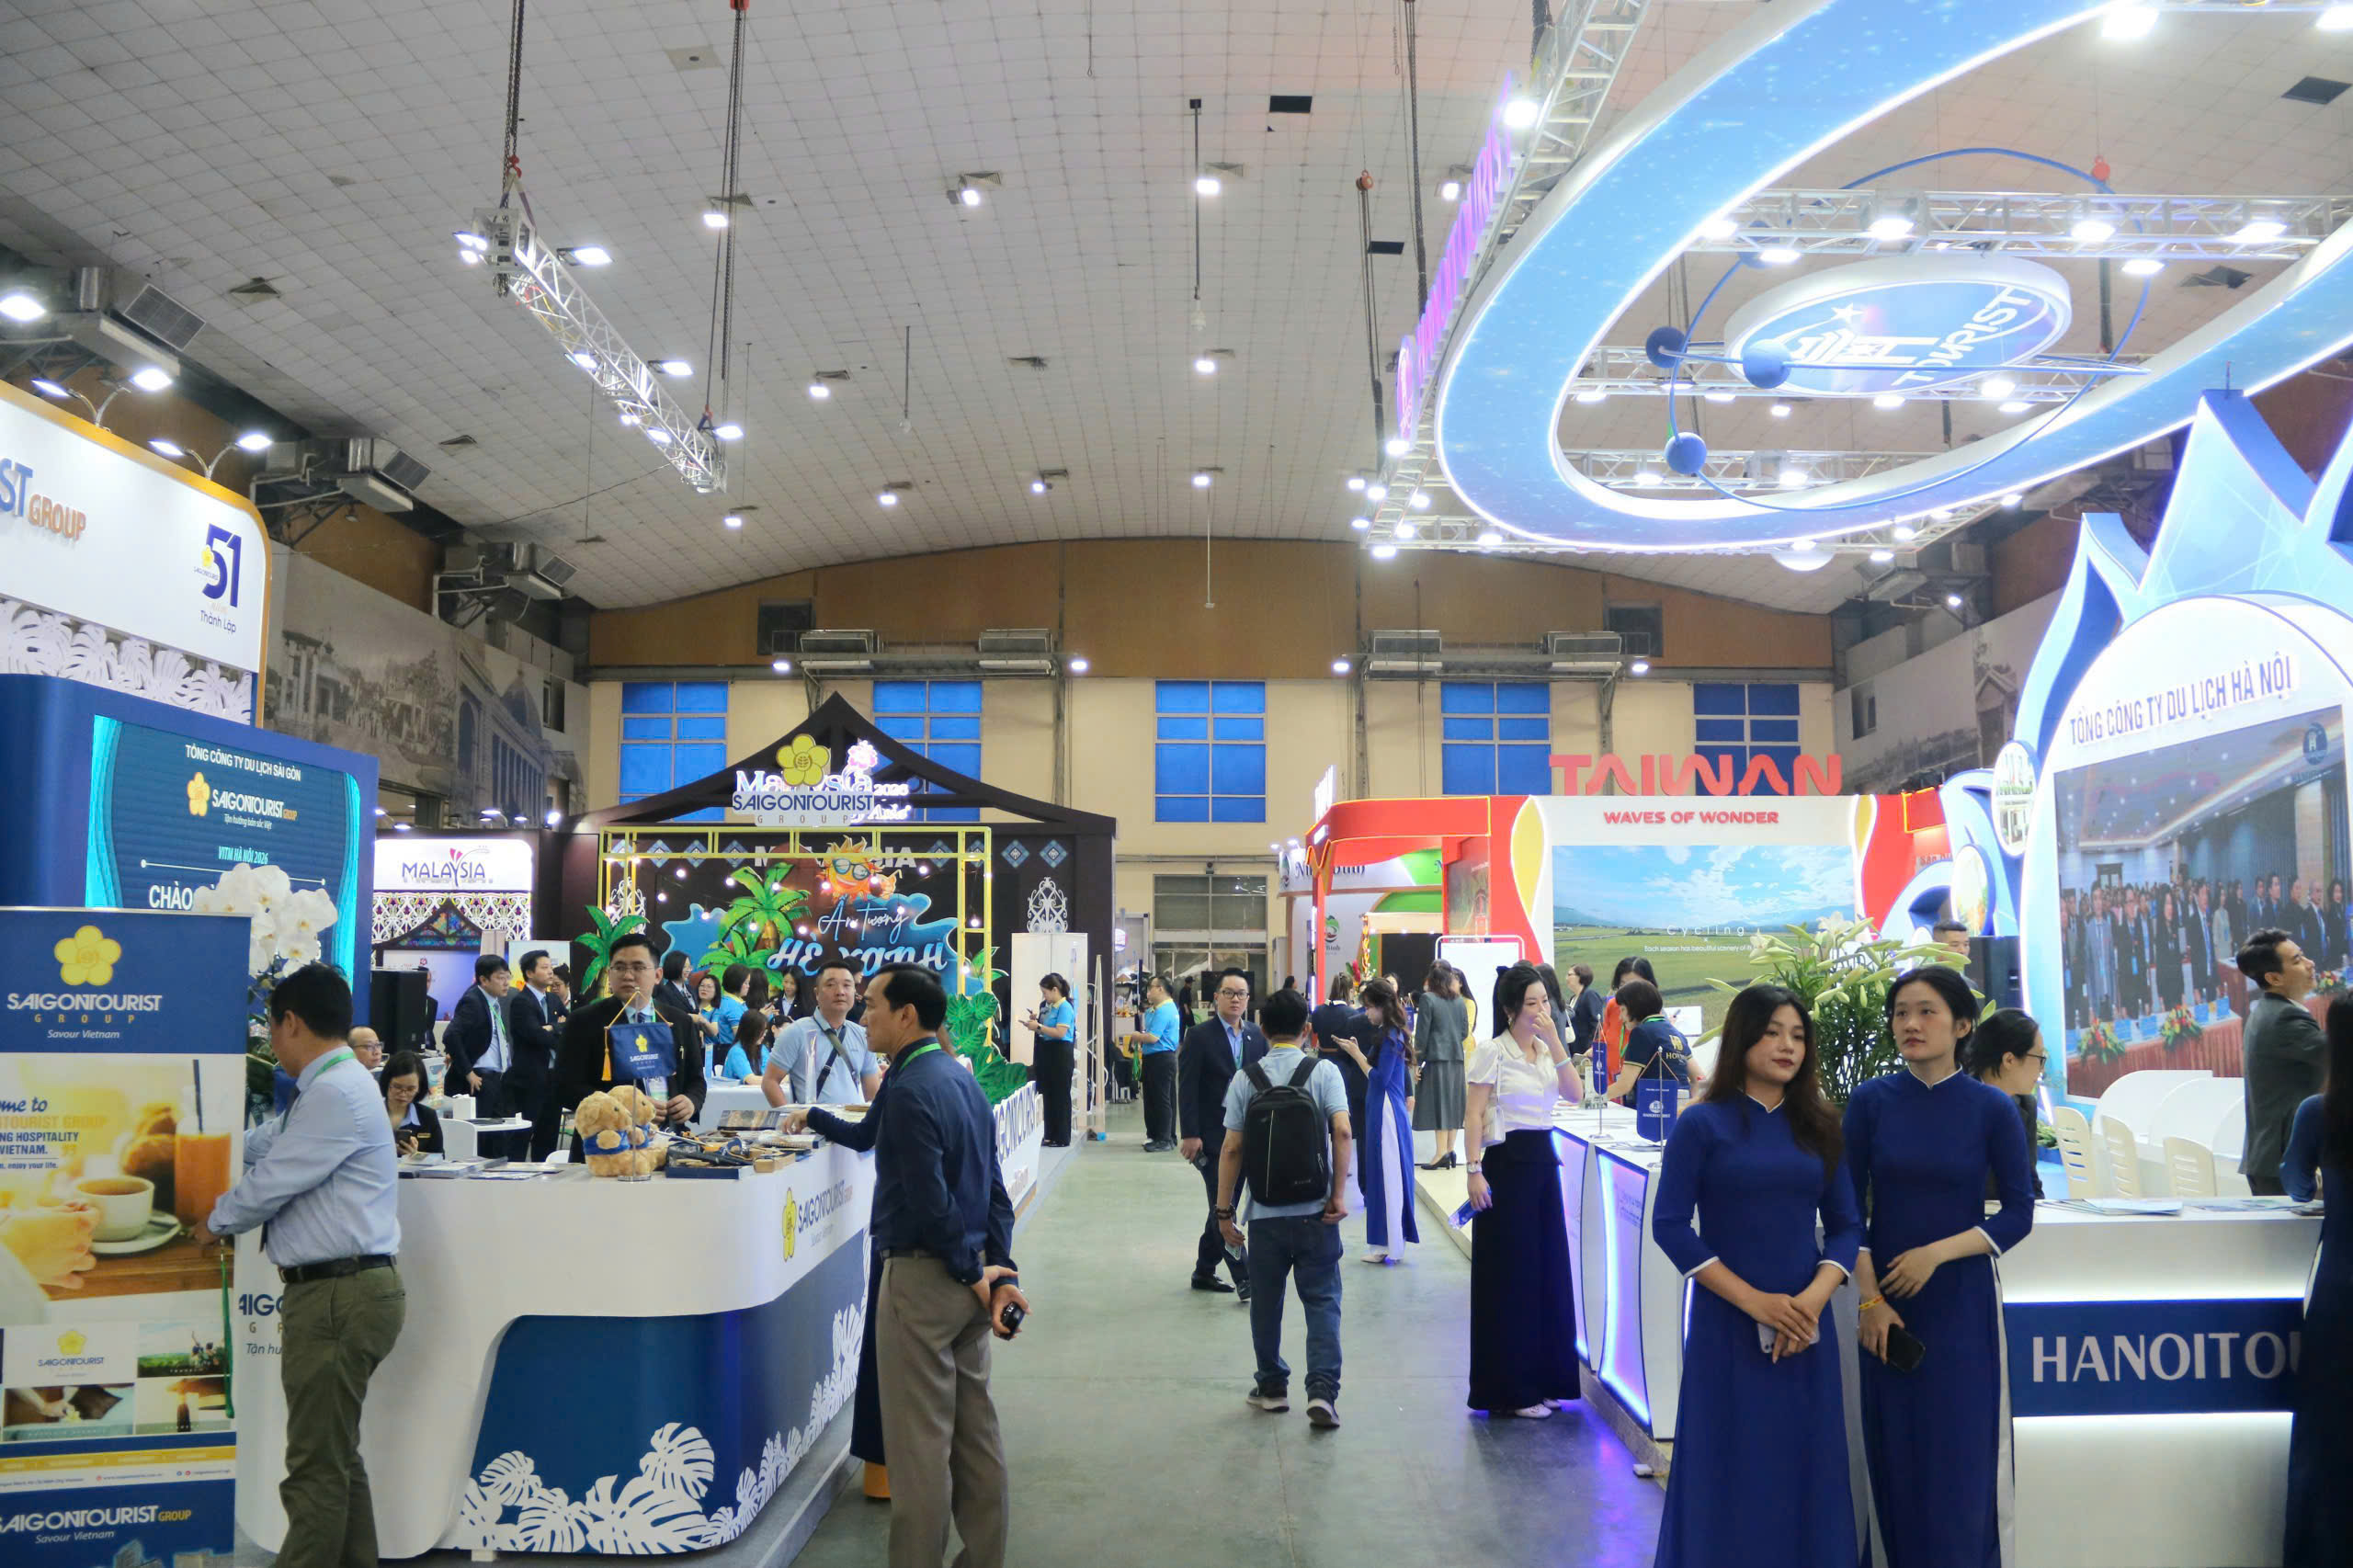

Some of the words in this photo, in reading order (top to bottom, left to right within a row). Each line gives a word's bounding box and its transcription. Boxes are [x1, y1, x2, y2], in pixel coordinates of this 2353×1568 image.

[28, 494, 86, 541] GROUP
[2107, 699, 2143, 737] CÔNG
[2146, 694, 2163, 726] TY
[2167, 687, 2187, 721] DU
[2191, 675, 2227, 720] LỊCH
[2232, 660, 2256, 703] HÀ
[2259, 651, 2292, 699] NỘI
[233, 756, 244, 768] TY
[244, 758, 255, 772] DU
[256, 760, 272, 777] LỊCH
[286, 766, 301, 781] GÒN
[1549, 754, 1843, 797] TAIWAN
[211, 789, 284, 818] SAIGONTOURIST
[733, 794, 873, 811] SAIGONTOURIST
[756, 814, 848, 824] GROUP
[1604, 811, 1666, 824] WAVES
[1671, 811, 1695, 824] OF
[1699, 811, 1779, 824] WONDER
[254, 850, 268, 865] 2026
[402, 861, 485, 887] MALAYSIA
[149, 881, 193, 911] CHÀO
[1666, 925, 1745, 937] Cycling
[7, 993, 163, 1011] SAIGONTOURIST
[34, 1014, 135, 1023] GROUP
[47, 1029, 79, 1040] Savour
[82, 1029, 119, 1040] Vietnam
[0, 1099, 27, 1113] me
[31, 1096, 48, 1112] to
[16, 1131, 79, 1142] HOSPITALITY
[7, 1162, 26, 1170] enjoy
[28, 1162, 43, 1170] your
[38, 1357, 104, 1367] SAIGONTOURIST
[0, 1506, 159, 1533] AIGONTOURIST
[158, 1510, 192, 1522] GROUP
[35, 1533, 71, 1544] Savour
[74, 1530, 115, 1541] Vietnam
